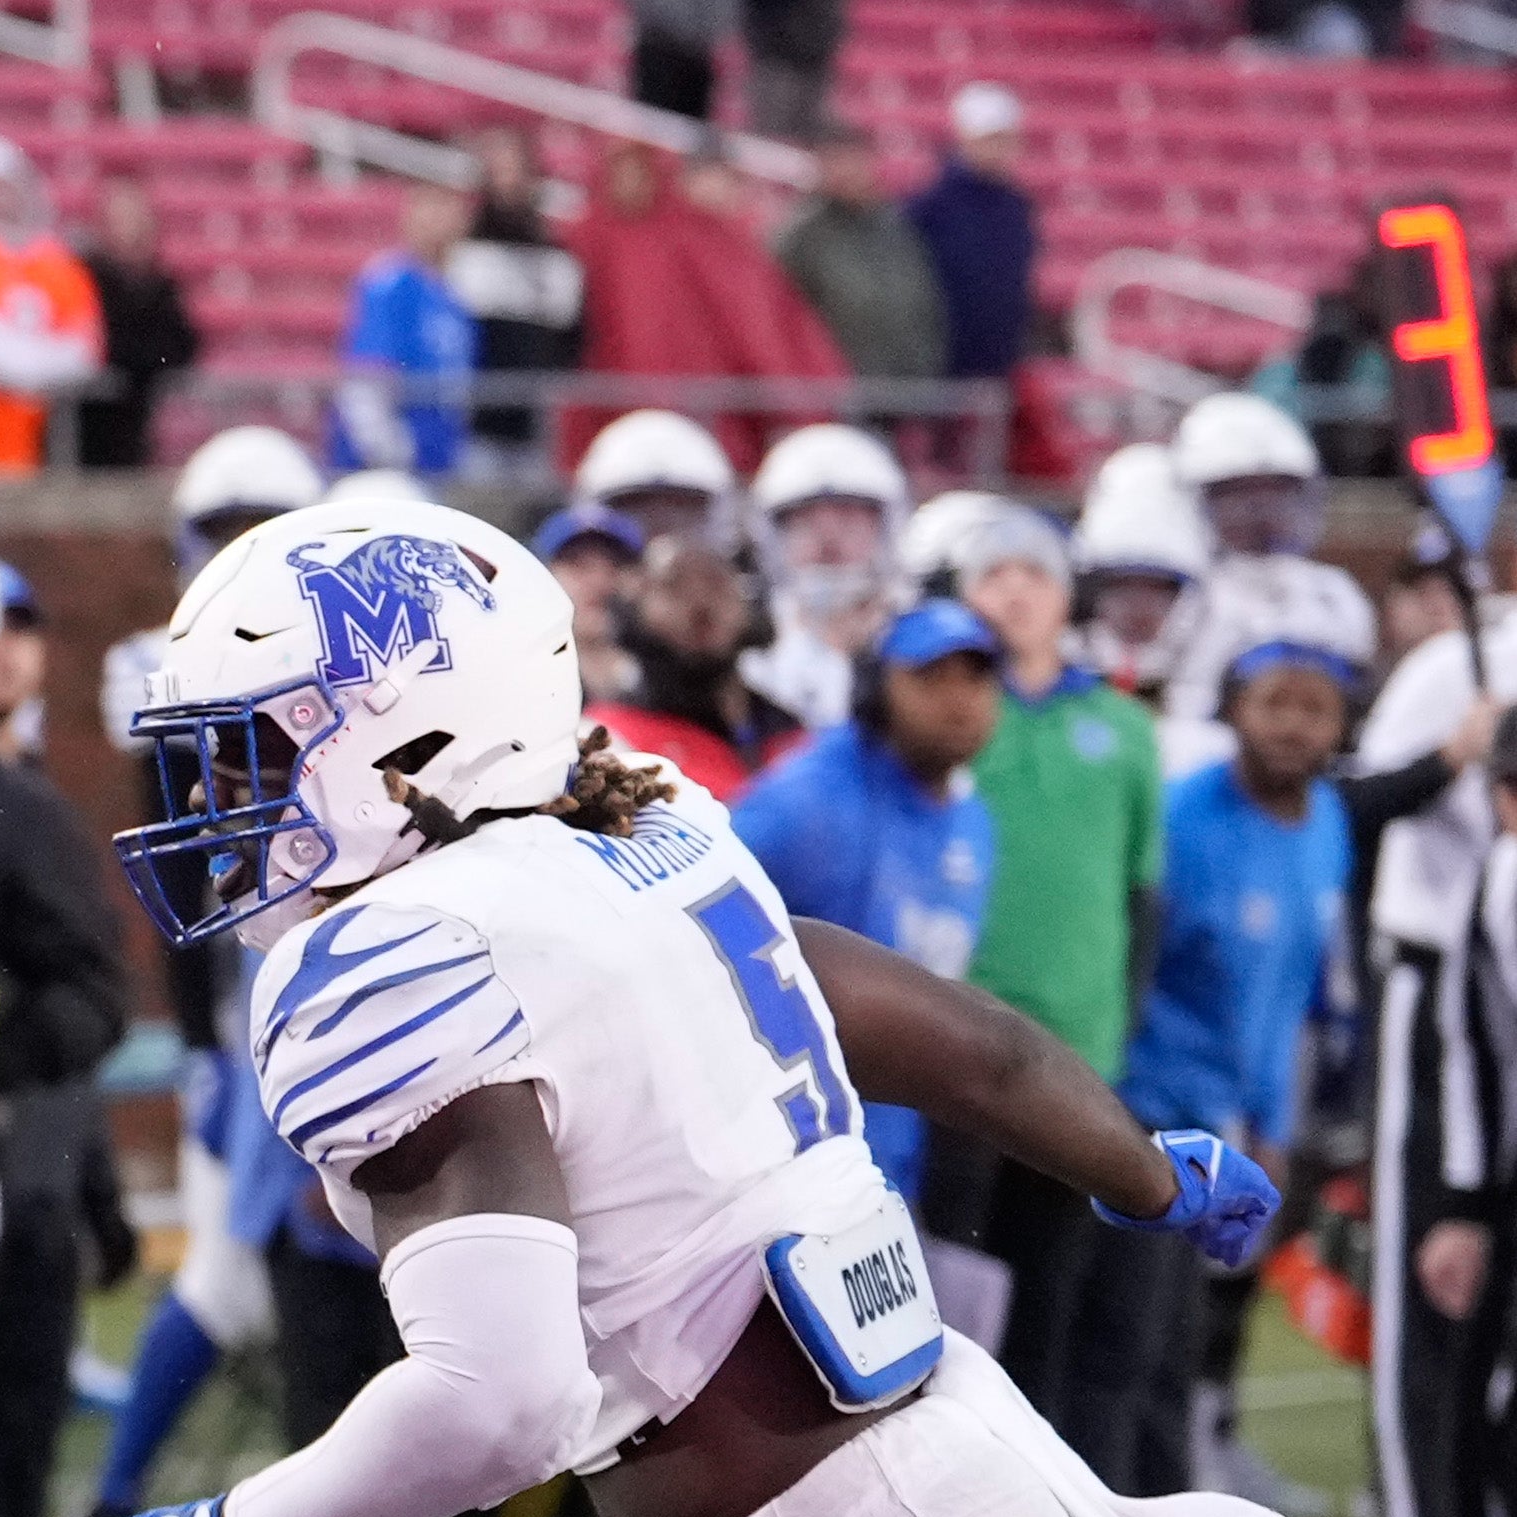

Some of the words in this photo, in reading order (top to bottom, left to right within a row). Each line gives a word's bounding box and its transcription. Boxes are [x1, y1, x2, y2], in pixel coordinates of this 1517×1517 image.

[297, 566, 453, 688] M
[682, 875, 853, 1158] 5
[841, 1239, 917, 1330] DOUGLAS
